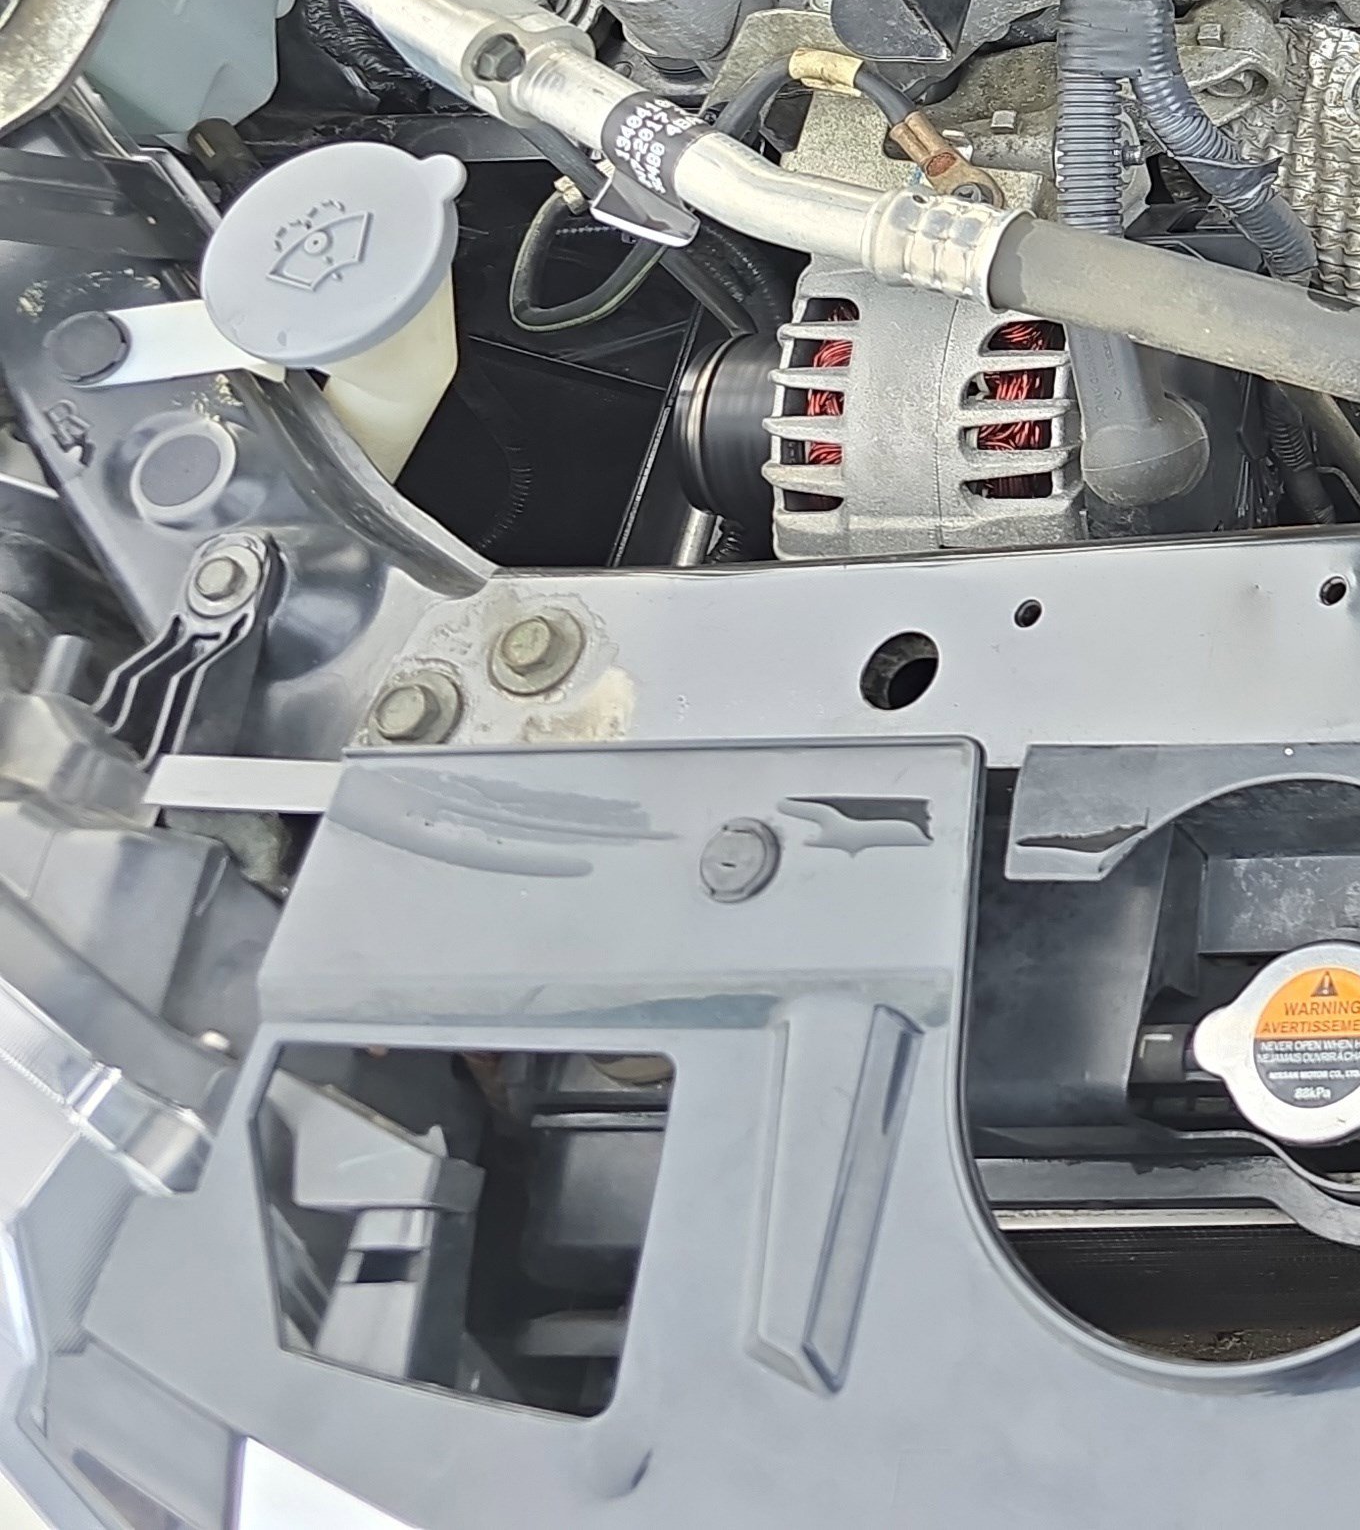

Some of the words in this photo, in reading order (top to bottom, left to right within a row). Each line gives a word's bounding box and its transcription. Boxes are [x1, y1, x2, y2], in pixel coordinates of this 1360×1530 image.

[1260, 1040, 1293, 1052] NEVER
[1294, 1040, 1321, 1051] OPEN
[1323, 1039, 1354, 1051] WHEN
